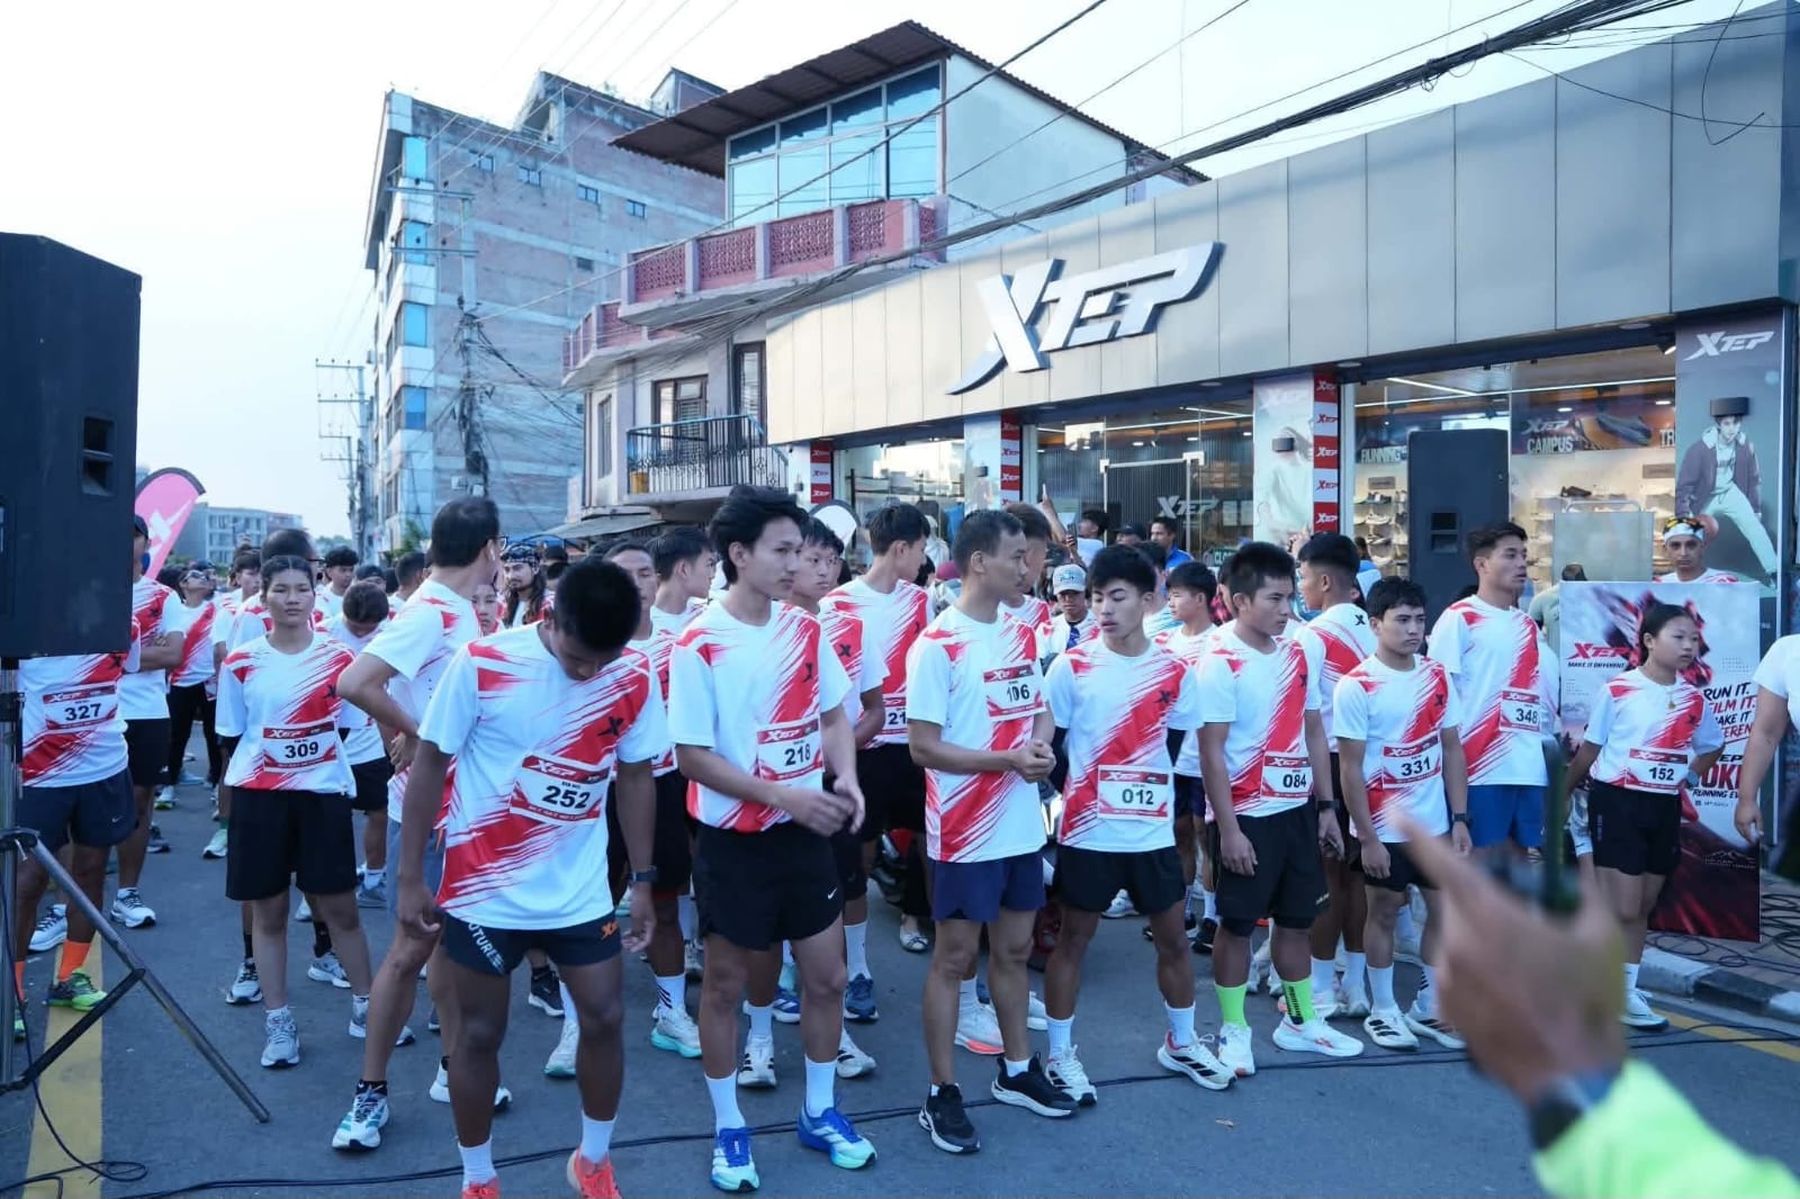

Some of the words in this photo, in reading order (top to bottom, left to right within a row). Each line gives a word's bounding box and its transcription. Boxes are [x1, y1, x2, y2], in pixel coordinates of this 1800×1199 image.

[946, 241, 1222, 395] XTEP
[1683, 331, 1775, 361] XTEP
[1316, 414, 1338, 423] XTEP
[1521, 419, 1569, 435] XTEP
[1527, 436, 1573, 455] CAMPUS
[1660, 429, 1676, 447] TR
[1316, 447, 1337, 457] XTEP
[1361, 446, 1401, 463] RUNNING
[1316, 480, 1338, 491] XTEP
[1157, 495, 1219, 519] XTEP
[1316, 513, 1337, 523] XTEP
[1566, 643, 1630, 659] XTEP
[1006, 684, 1030, 702] 106
[1703, 685, 1732, 701] RUN
[1735, 682, 1752, 697] IT.
[1740, 695, 1757, 710] IT.
[64, 703, 102, 721] 327
[887, 711, 906, 725] 21
[1515, 708, 1538, 724] 348
[1715, 713, 1738, 726] AKE
[1740, 711, 1752, 722] IT
[267, 729, 302, 738] XTEP
[285, 741, 319, 759] 309
[784, 743, 811, 766] 218
[1719, 754, 1743, 762] EP
[528, 760, 577, 775] XTEP
[1401, 756, 1430, 776] 331
[1649, 767, 1674, 781] 152
[1283, 774, 1307, 788] 084
[542, 785, 590, 808] 252
[1122, 788, 1154, 805] 012
[1693, 789, 1728, 798] RUNNING
[468, 923, 499, 960] UTURE
